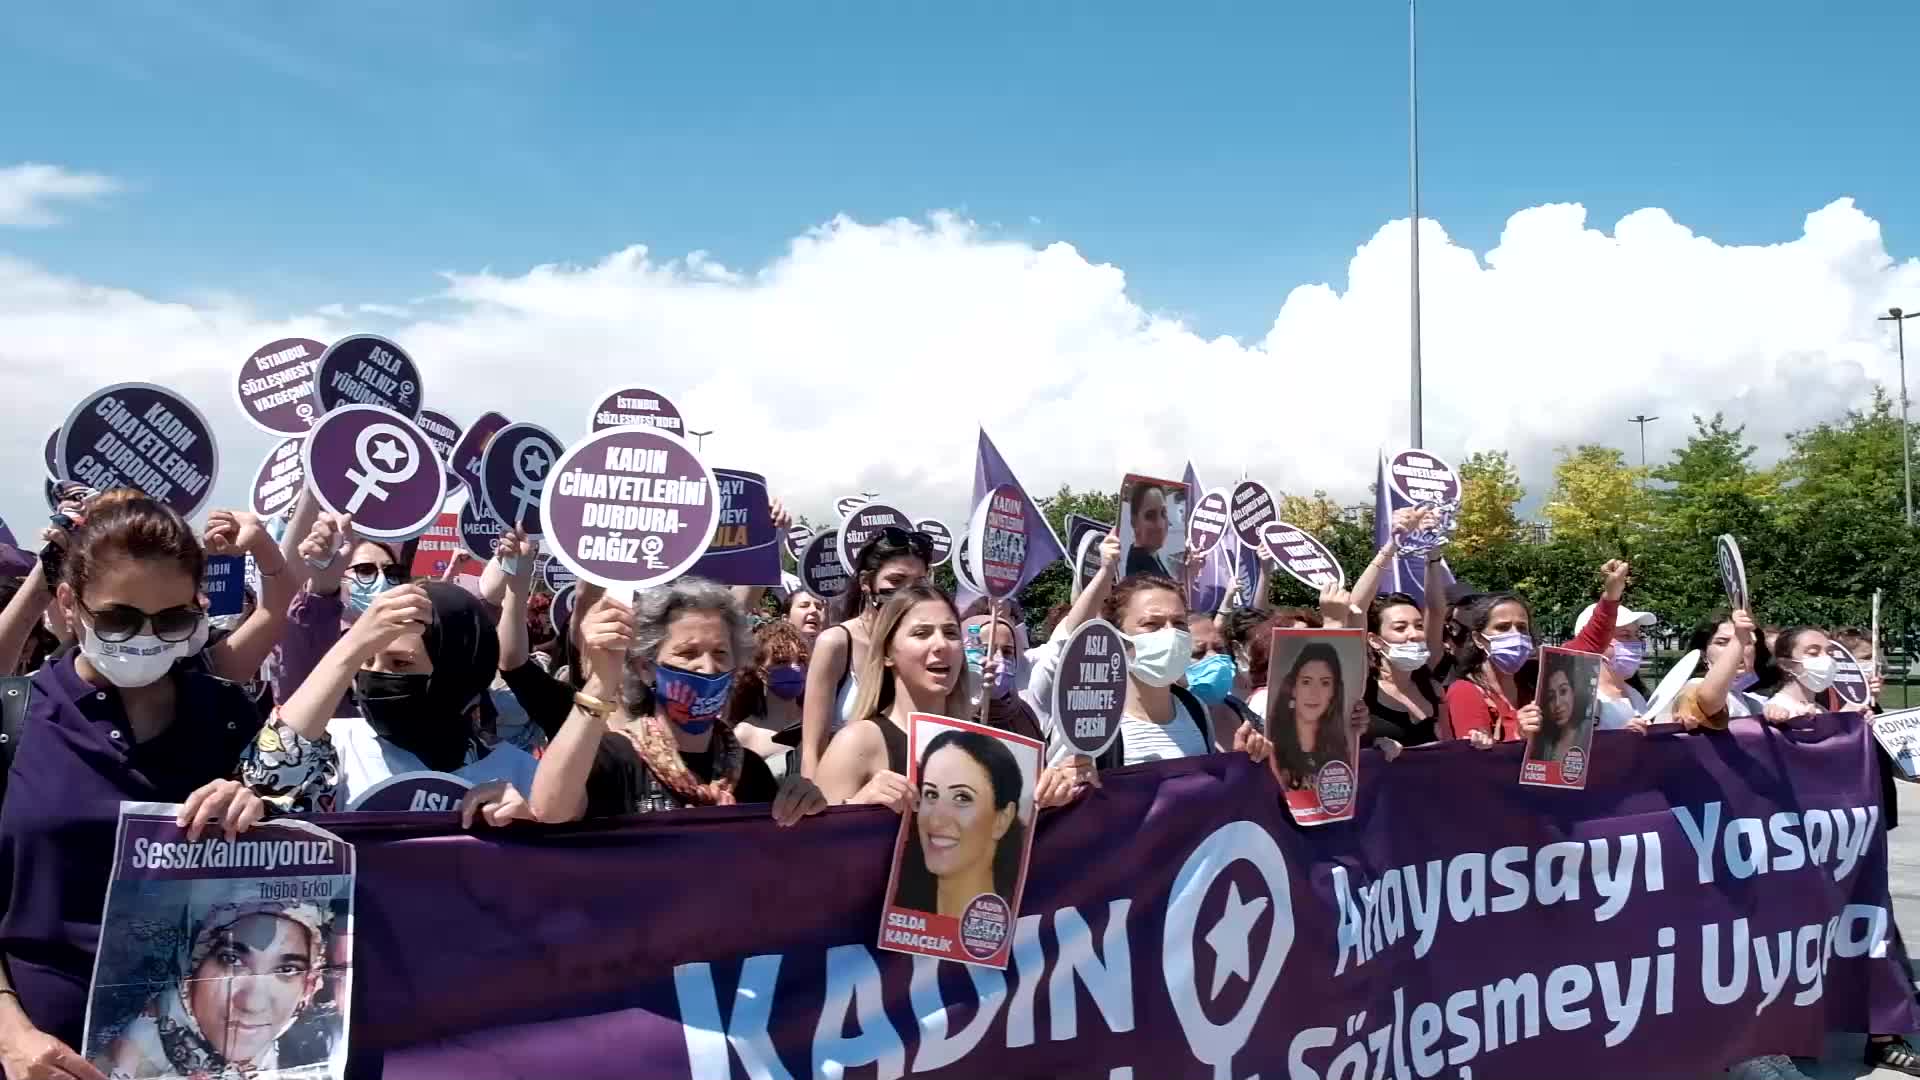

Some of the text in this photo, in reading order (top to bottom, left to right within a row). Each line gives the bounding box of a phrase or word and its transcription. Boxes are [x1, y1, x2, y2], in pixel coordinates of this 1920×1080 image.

[255, 344, 310, 371] İSTANBUL
[368, 346, 402, 374] ASLA
[355, 360, 398, 396] YALNIZ
[617, 396, 661, 411] İSTANBUL
[143, 402, 197, 452] KADIN
[95, 396, 210, 497] CİNAYETLERİNİ
[605, 446, 668, 474] KADIN
[559, 467, 707, 506] CİNAYETLERİNİ
[582, 502, 688, 533] DURDURA-
[577, 531, 641, 563] CAĞIZ
[1085, 635, 1108, 656] ASLA
[1080, 662, 1110, 683] YALNIZ
[1075, 713, 1106, 738] CEKSİN
[256, 879, 333, 900] Tuğba Erkol
[1332, 802, 1879, 978] Anayasayı Yasayı
[887, 913, 927, 931] SELDA
[884, 928, 953, 951] KARAÇELİK
[673, 898, 1135, 1080] KADIN
